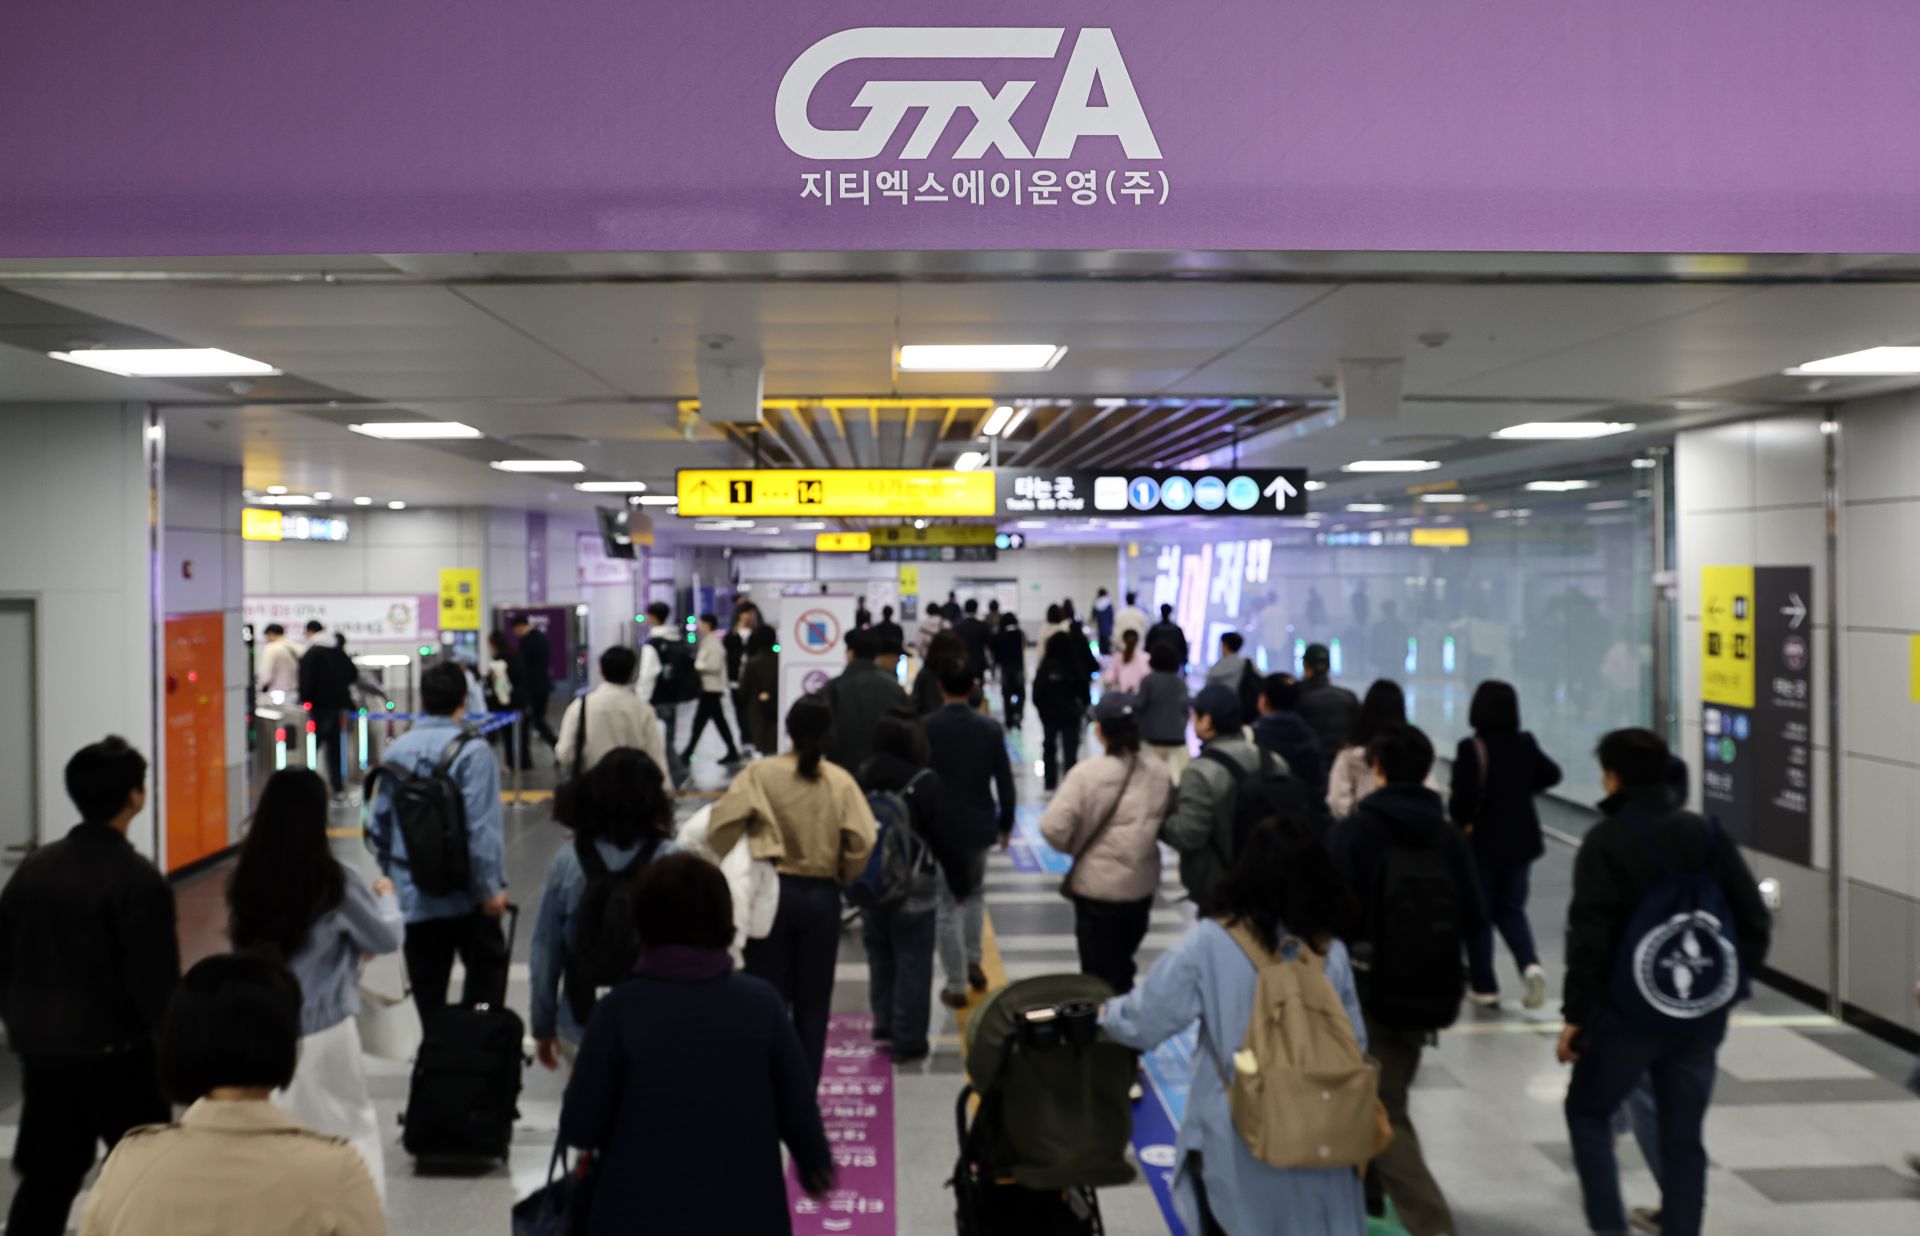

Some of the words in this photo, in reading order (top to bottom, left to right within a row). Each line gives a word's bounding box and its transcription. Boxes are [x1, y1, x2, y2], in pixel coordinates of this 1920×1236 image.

[800, 169, 1170, 206] 지티엑스에이운영(주)
[732, 481, 749, 503] 1
[799, 480, 822, 503] 14
